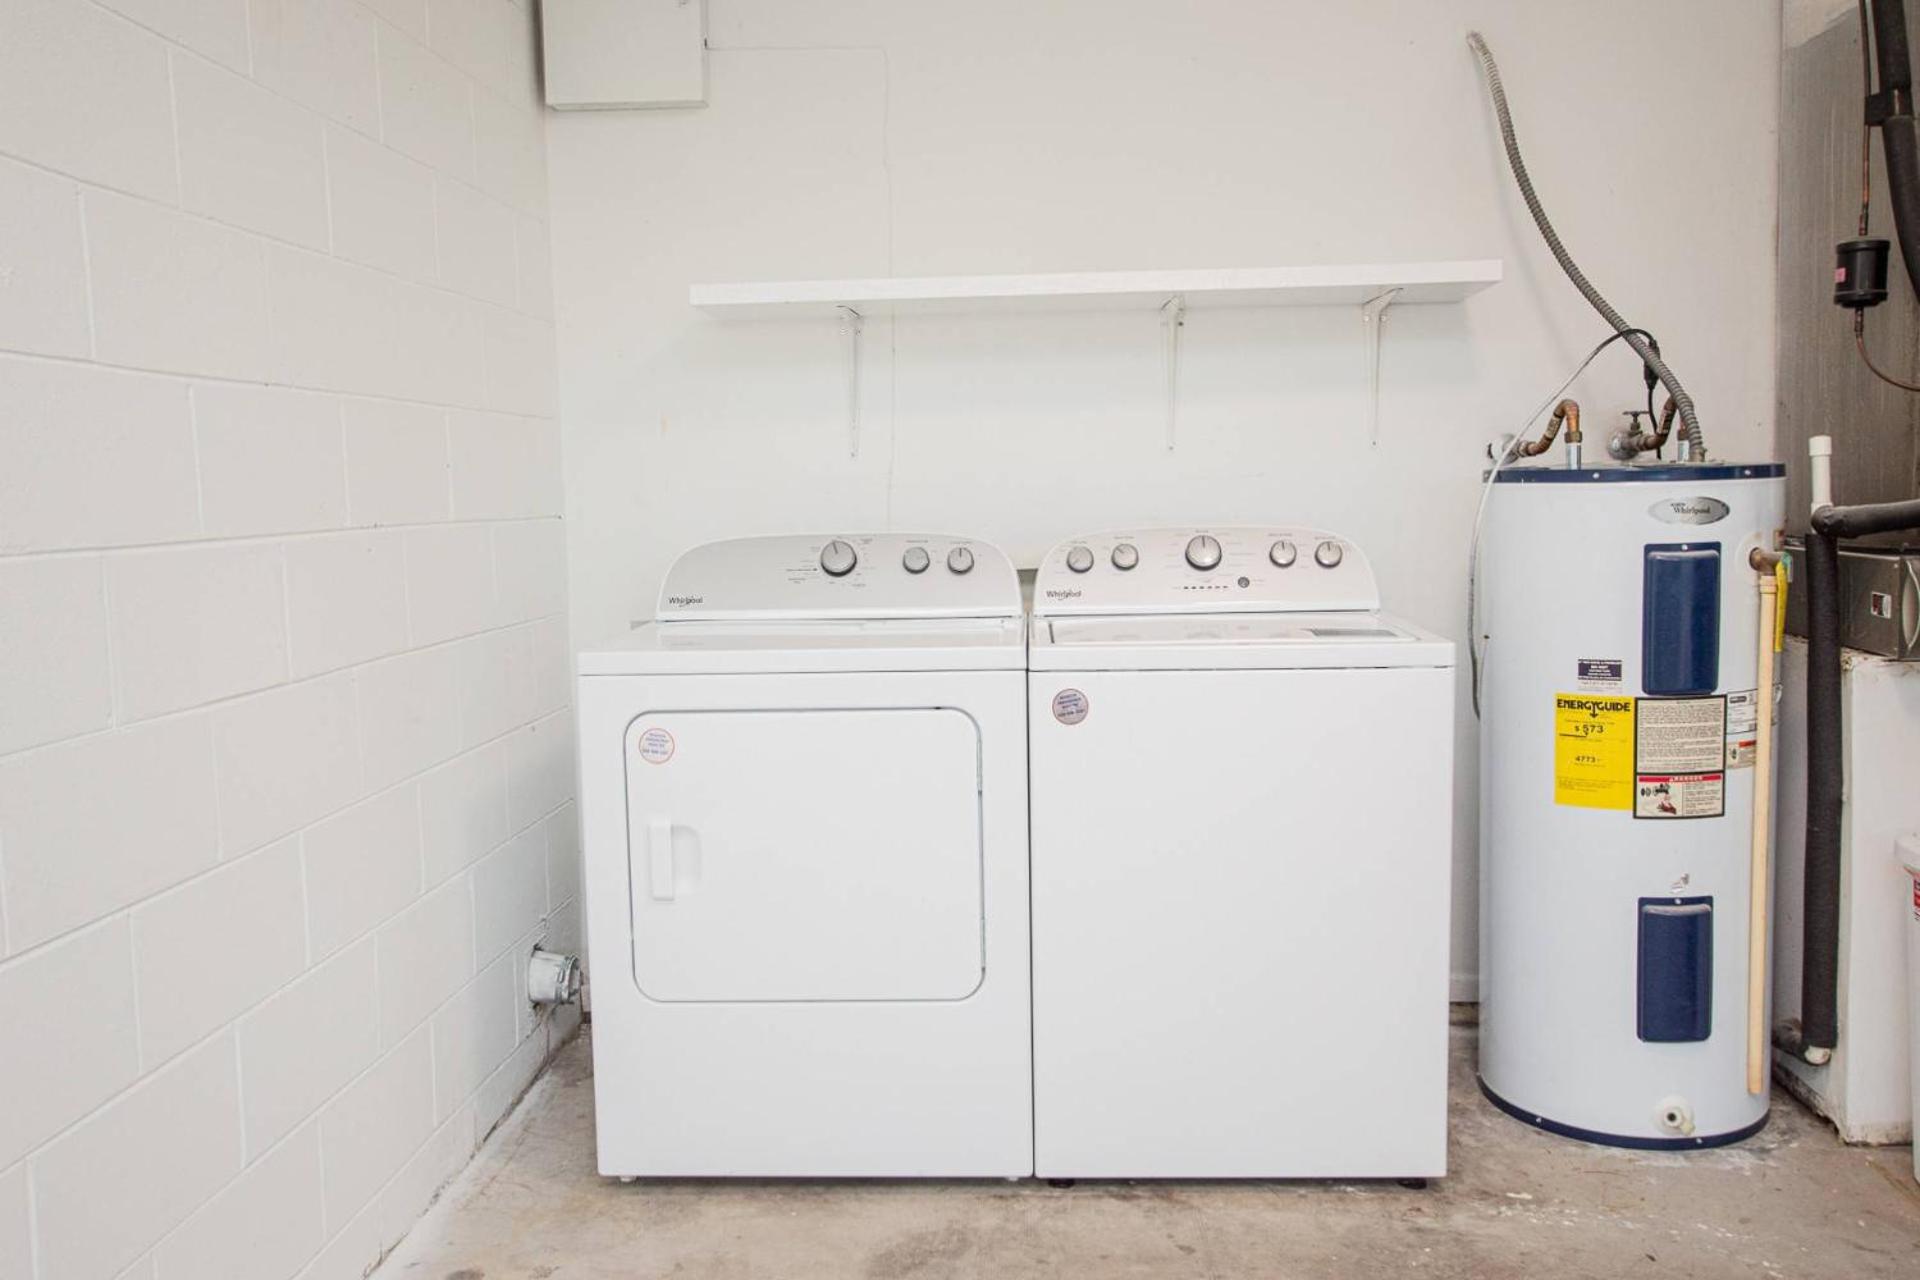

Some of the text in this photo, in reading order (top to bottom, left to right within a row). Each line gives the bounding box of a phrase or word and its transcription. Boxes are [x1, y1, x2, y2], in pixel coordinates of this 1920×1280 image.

[1671, 502, 1711, 516] Whirlpool
[668, 595, 704, 608] Whirlpool
[1046, 589, 1082, 601] Whirlpool
[1557, 698, 1631, 713] ENERGYGUIDE
[1582, 723, 1604, 734] 573
